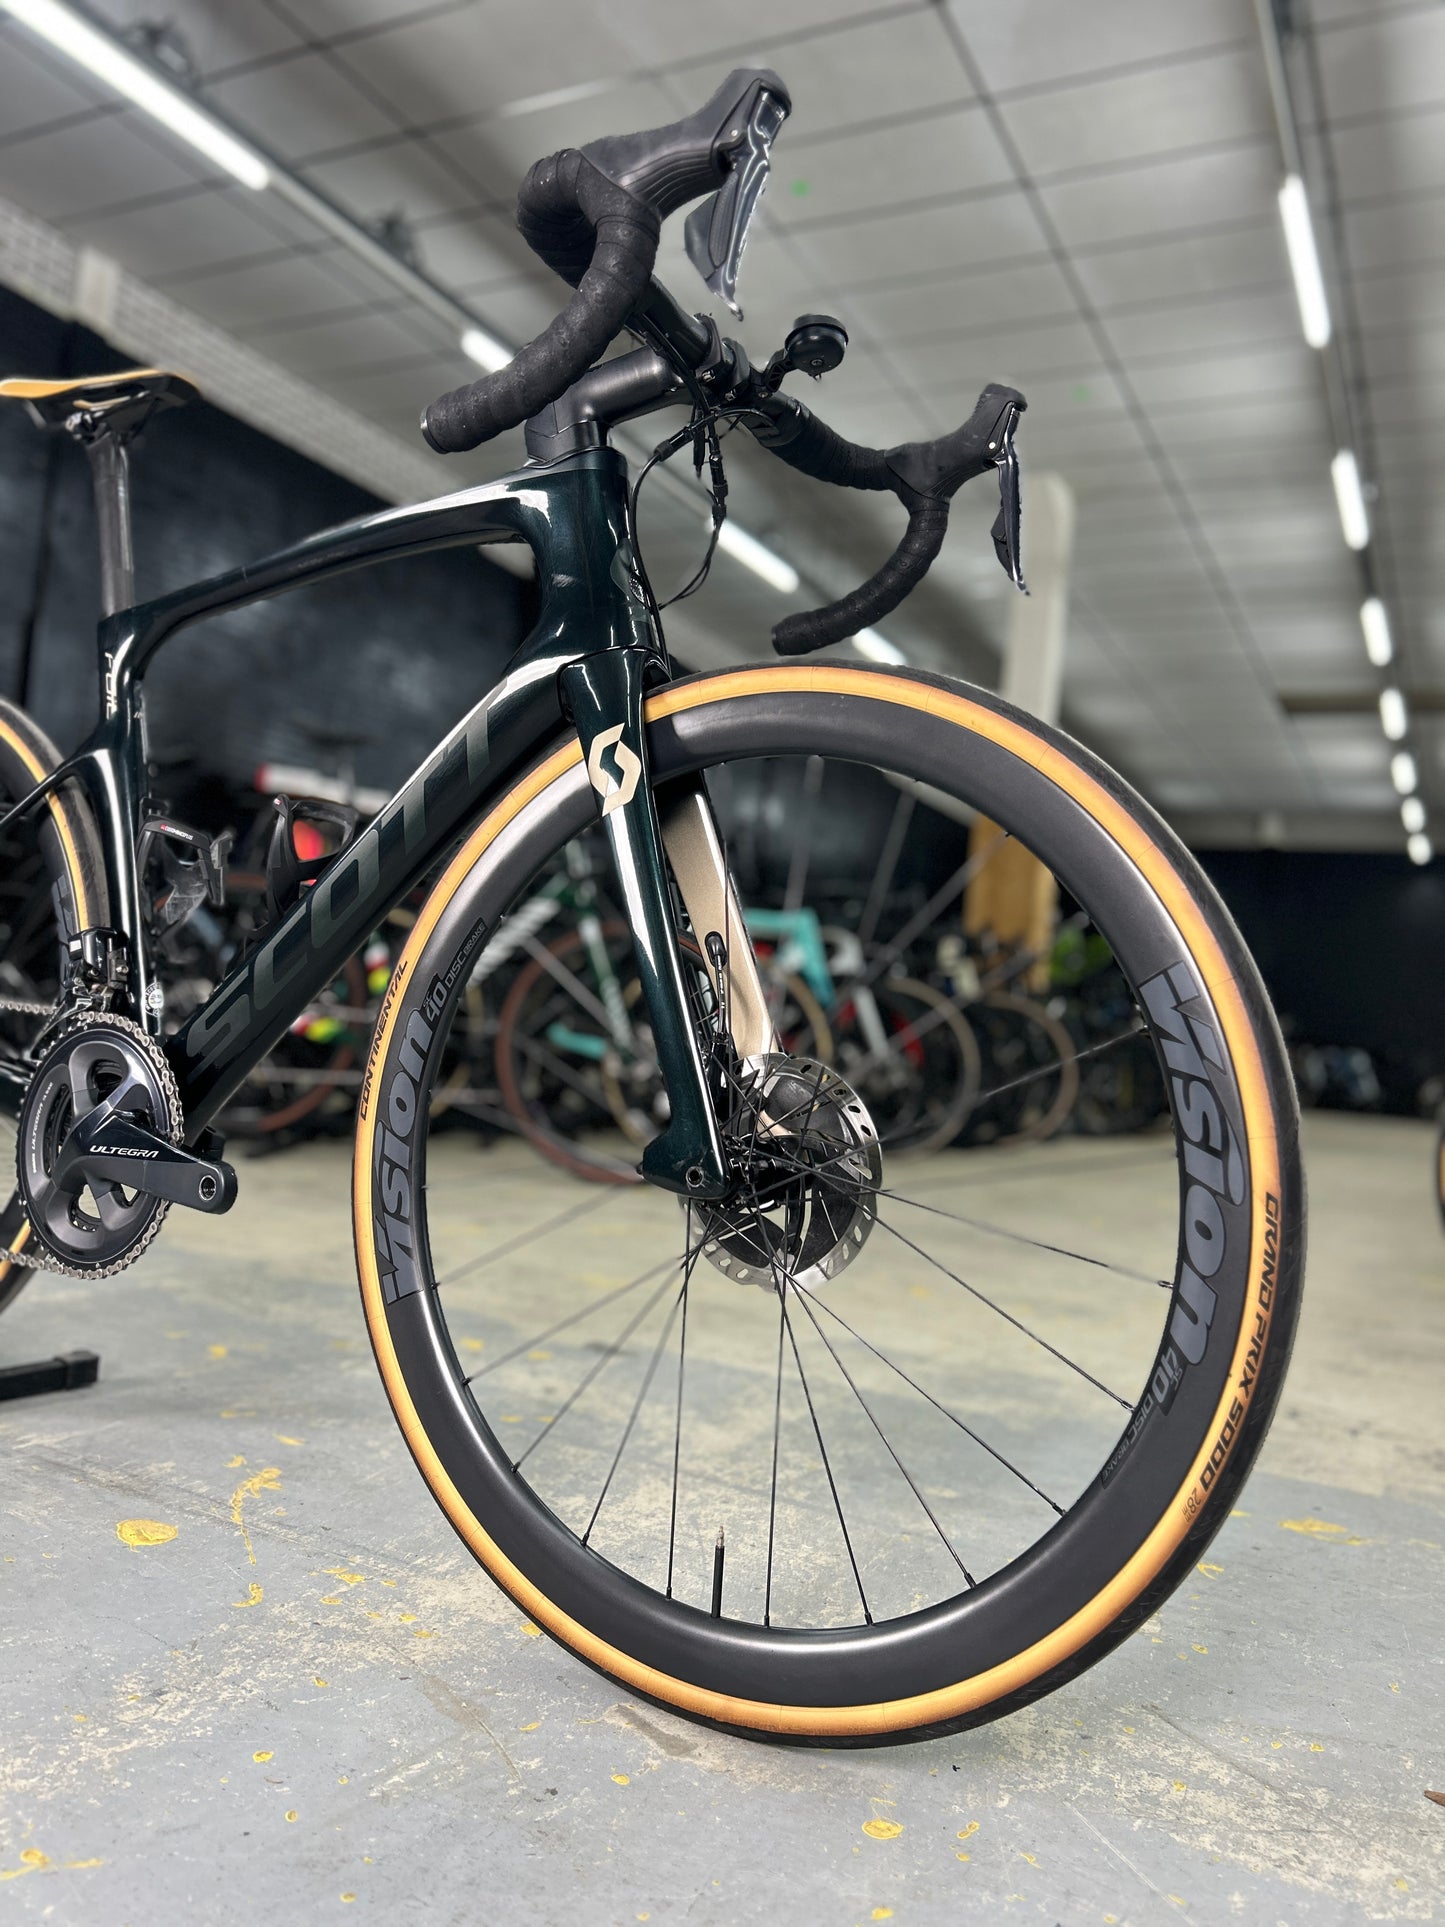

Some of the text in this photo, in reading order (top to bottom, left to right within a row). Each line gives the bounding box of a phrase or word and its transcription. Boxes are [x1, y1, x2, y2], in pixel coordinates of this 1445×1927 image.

[186, 676, 508, 1083] SCOTT
[426, 981, 448, 1022] 40
[444, 951, 467, 989] DISC
[464, 922, 486, 956] BRAKE
[359, 958, 409, 1121] CONTINENTAL
[89, 1144, 160, 1159] ULTEGRA
[1258, 1191, 1281, 1318] GRAND
[1152, 1346, 1179, 1404] 40
[1237, 1313, 1269, 1398] PRIX
[1102, 1438, 1131, 1481] BRAKE
[1127, 1392, 1154, 1445] DISC
[1199, 1397, 1246, 1493] 5000
